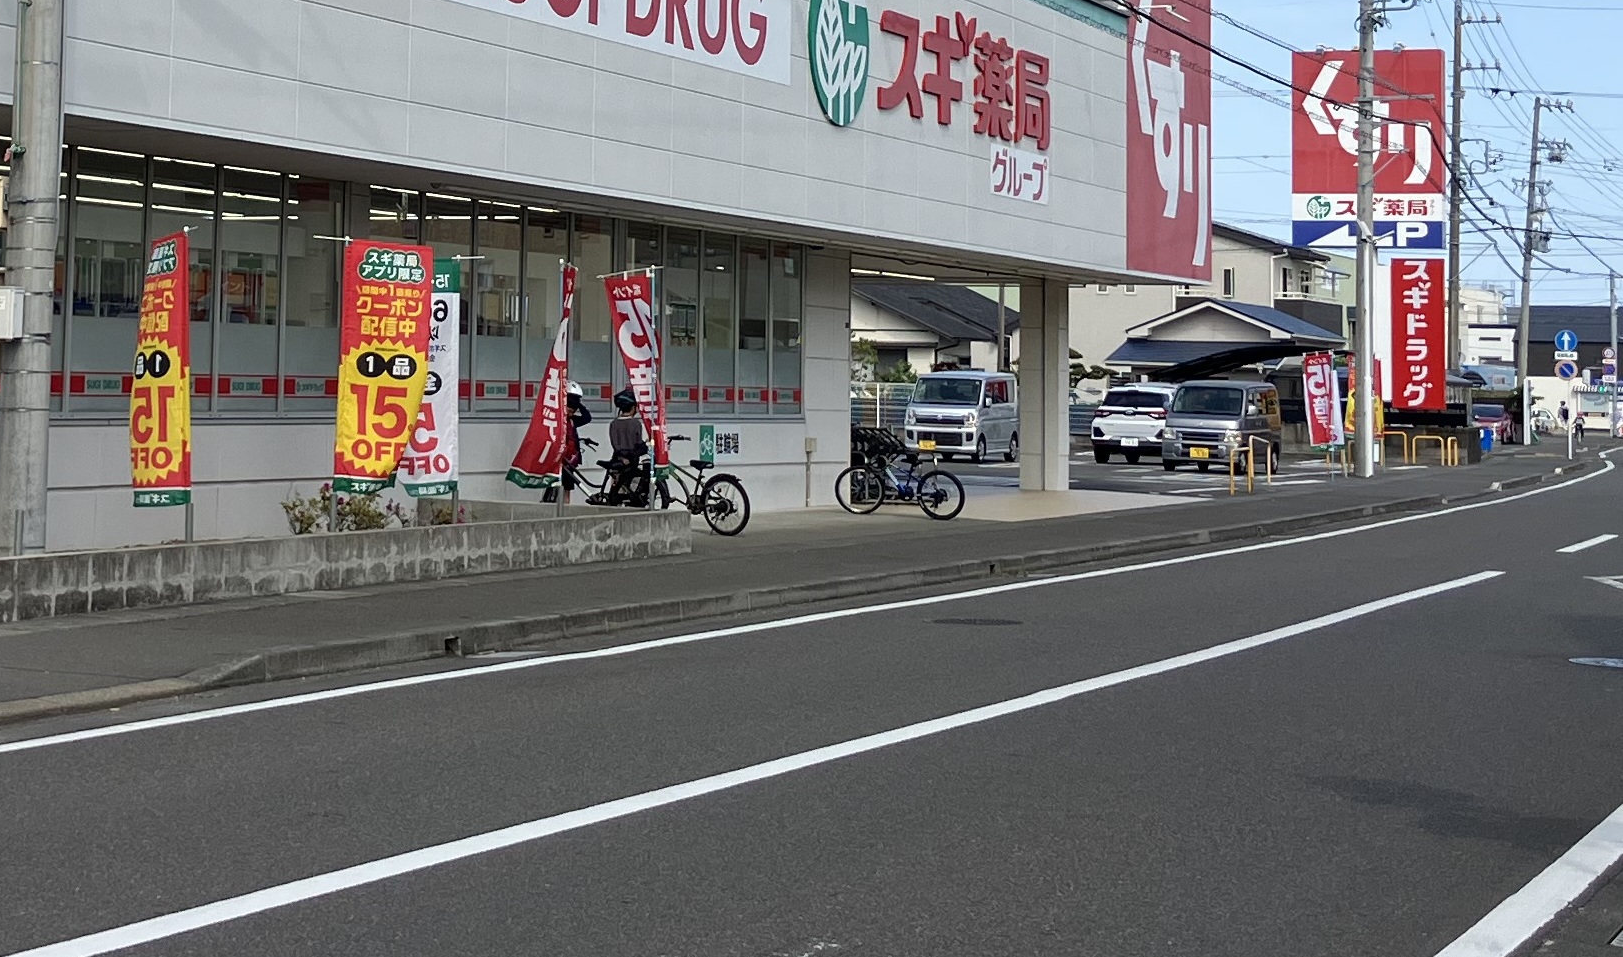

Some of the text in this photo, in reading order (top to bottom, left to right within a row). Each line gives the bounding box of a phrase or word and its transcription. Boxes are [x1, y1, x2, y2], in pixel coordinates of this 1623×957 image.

[877, 9, 1052, 150] スギ薬局
[991, 154, 1050, 202] グループ
[1336, 197, 1427, 216] ス薬局
[1397, 222, 1428, 247] P
[367, 251, 418, 267] スギ薬局
[362, 264, 422, 281] アプリ限定
[356, 296, 423, 317] クーポン
[360, 315, 417, 338] 配信中
[1401, 260, 1434, 408] スギドラッグ
